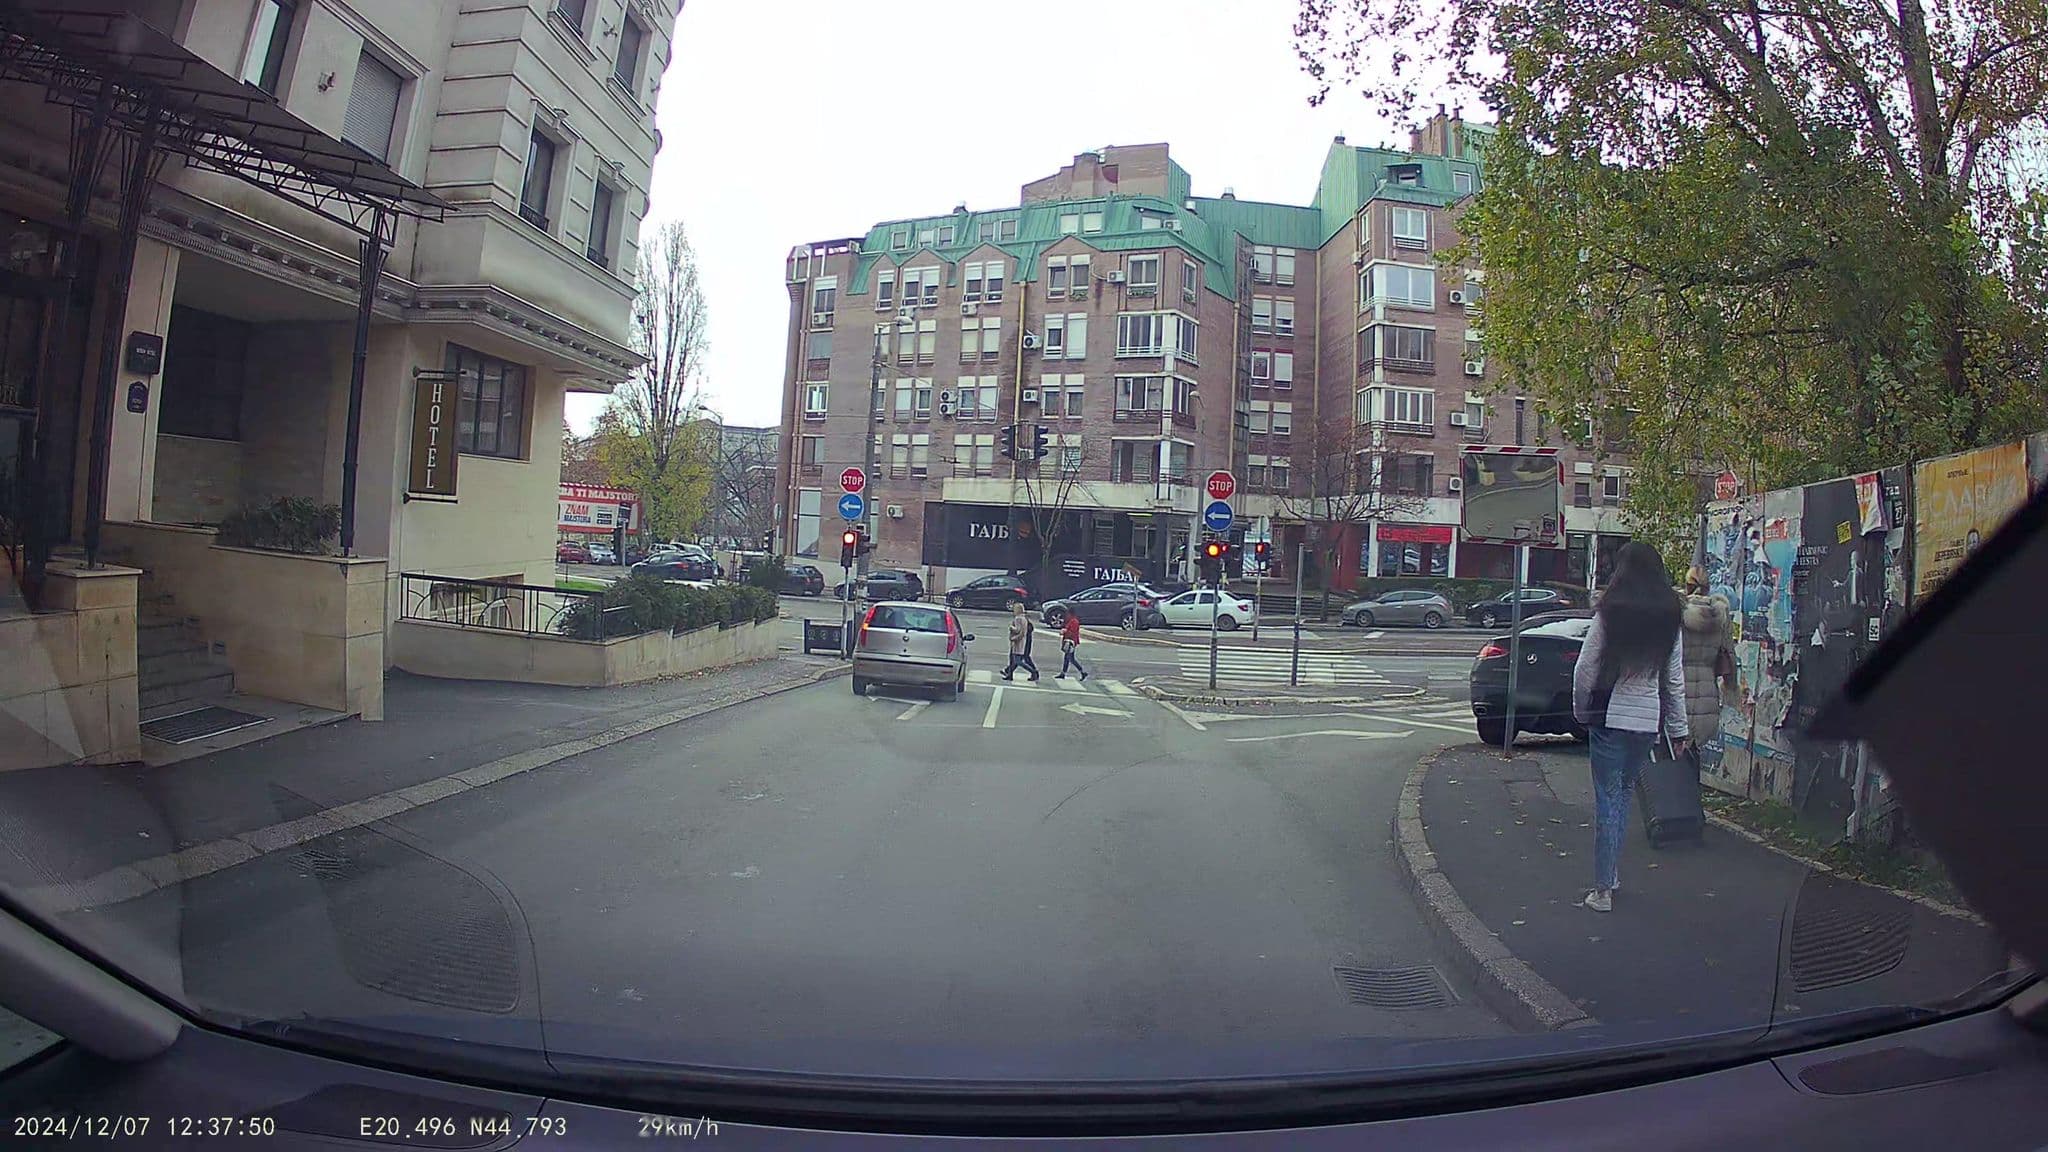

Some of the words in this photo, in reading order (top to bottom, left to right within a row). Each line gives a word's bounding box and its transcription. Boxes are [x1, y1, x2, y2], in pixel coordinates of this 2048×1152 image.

[426, 383, 443, 489] HOTEL
[842, 475, 863, 486] STOP
[1209, 480, 1232, 491] STOP
[575, 488, 587, 498] TI
[1717, 481, 1735, 493] STOP
[565, 503, 589, 515] ZNAM
[1094, 567, 1133, 582] ГАЈБА
